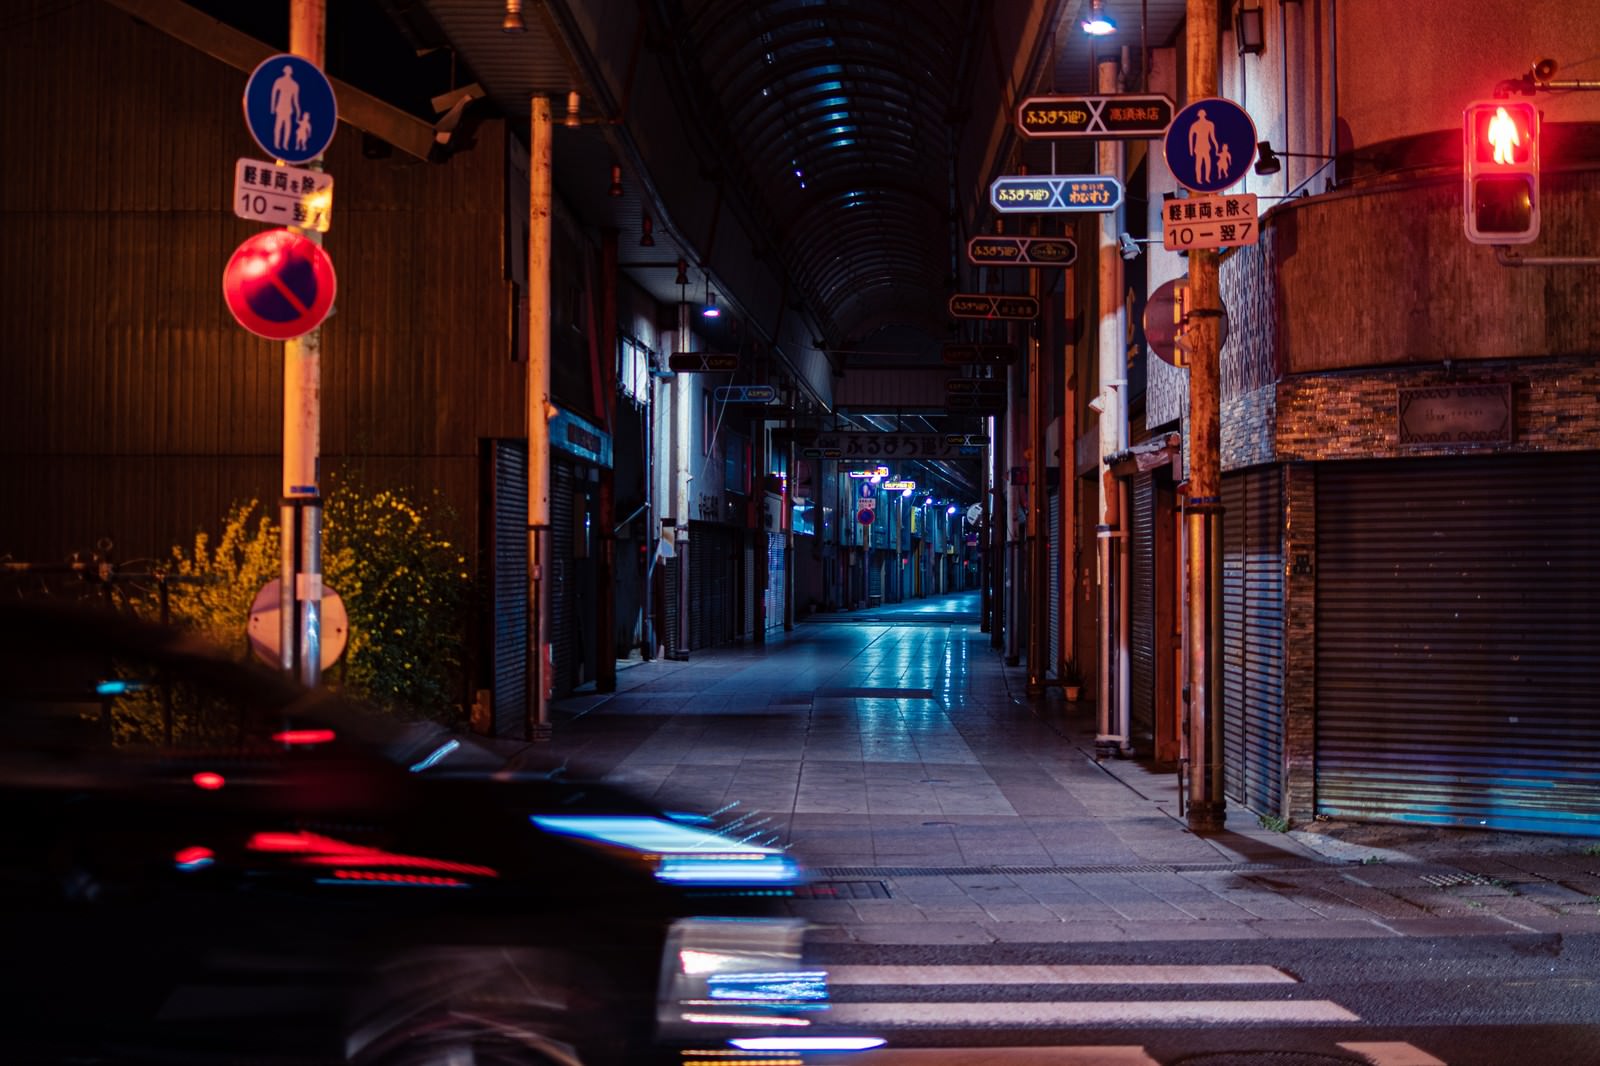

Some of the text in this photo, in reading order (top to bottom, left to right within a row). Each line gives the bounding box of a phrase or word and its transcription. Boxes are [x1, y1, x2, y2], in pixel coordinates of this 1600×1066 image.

[1026, 110, 1087, 124] ふるまち通り
[999, 189, 1050, 201] ふるまち通り
[1169, 200, 1252, 222] 軽車両を除く
